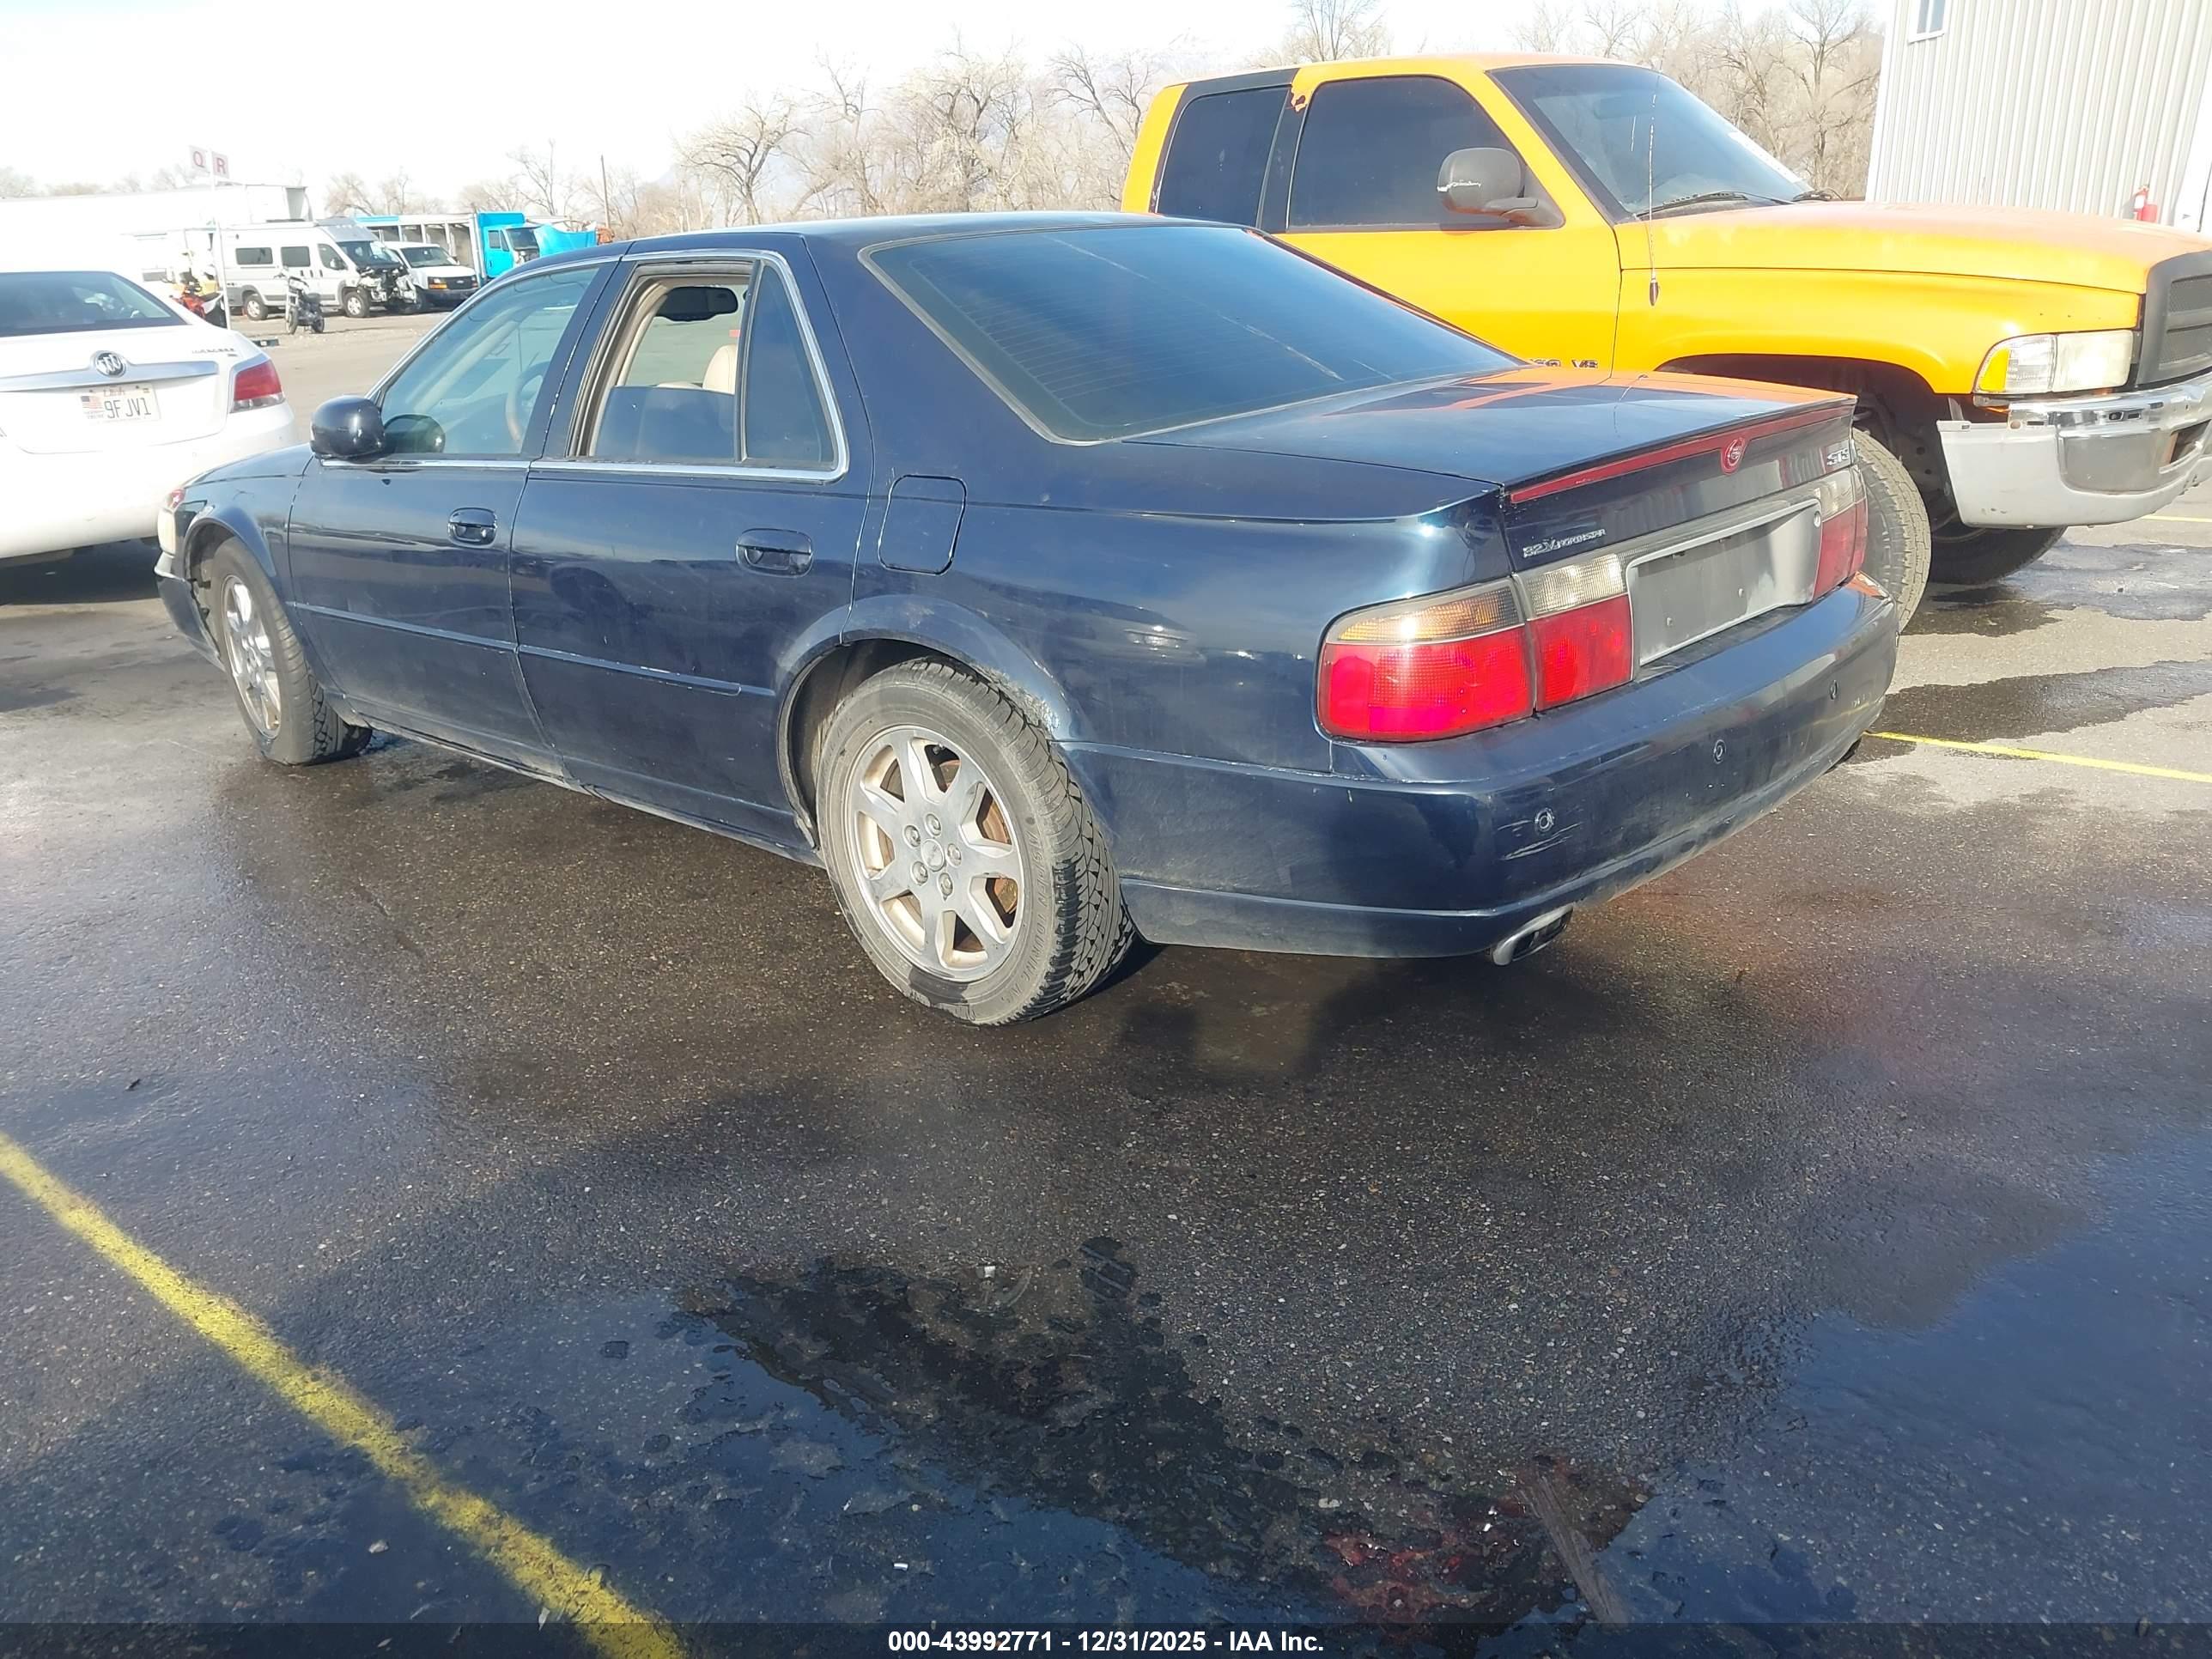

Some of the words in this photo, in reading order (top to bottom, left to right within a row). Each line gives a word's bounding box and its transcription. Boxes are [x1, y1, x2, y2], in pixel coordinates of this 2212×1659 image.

[192, 150, 205, 168] Q
[216, 157, 226, 174] R
[1021, 914, 1046, 981] TOURING
